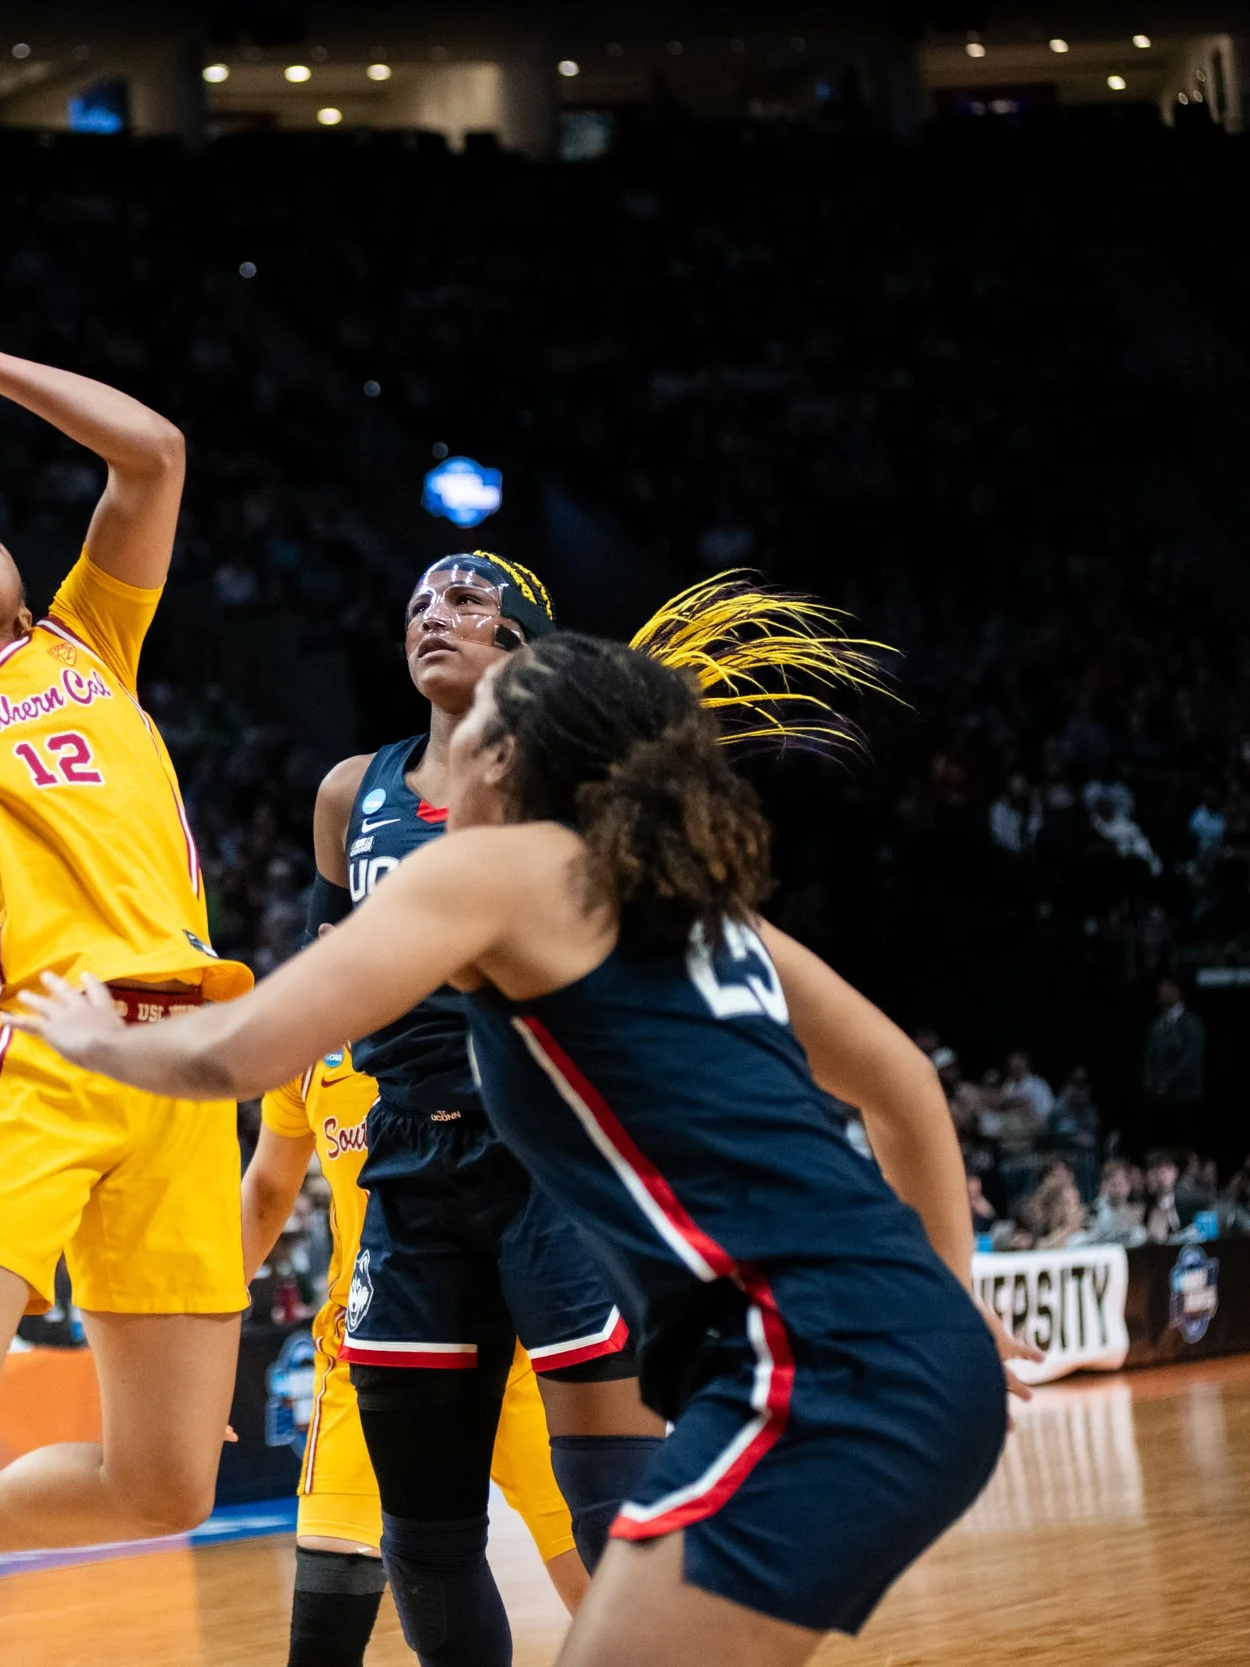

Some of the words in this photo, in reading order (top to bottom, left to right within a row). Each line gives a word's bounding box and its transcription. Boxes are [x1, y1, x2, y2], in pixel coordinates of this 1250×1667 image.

[61, 668, 112, 706] Cal
[14, 731, 104, 786] 12
[430, 1110, 462, 1122] UCONN
[980, 1263, 1110, 1352] ERSITY
